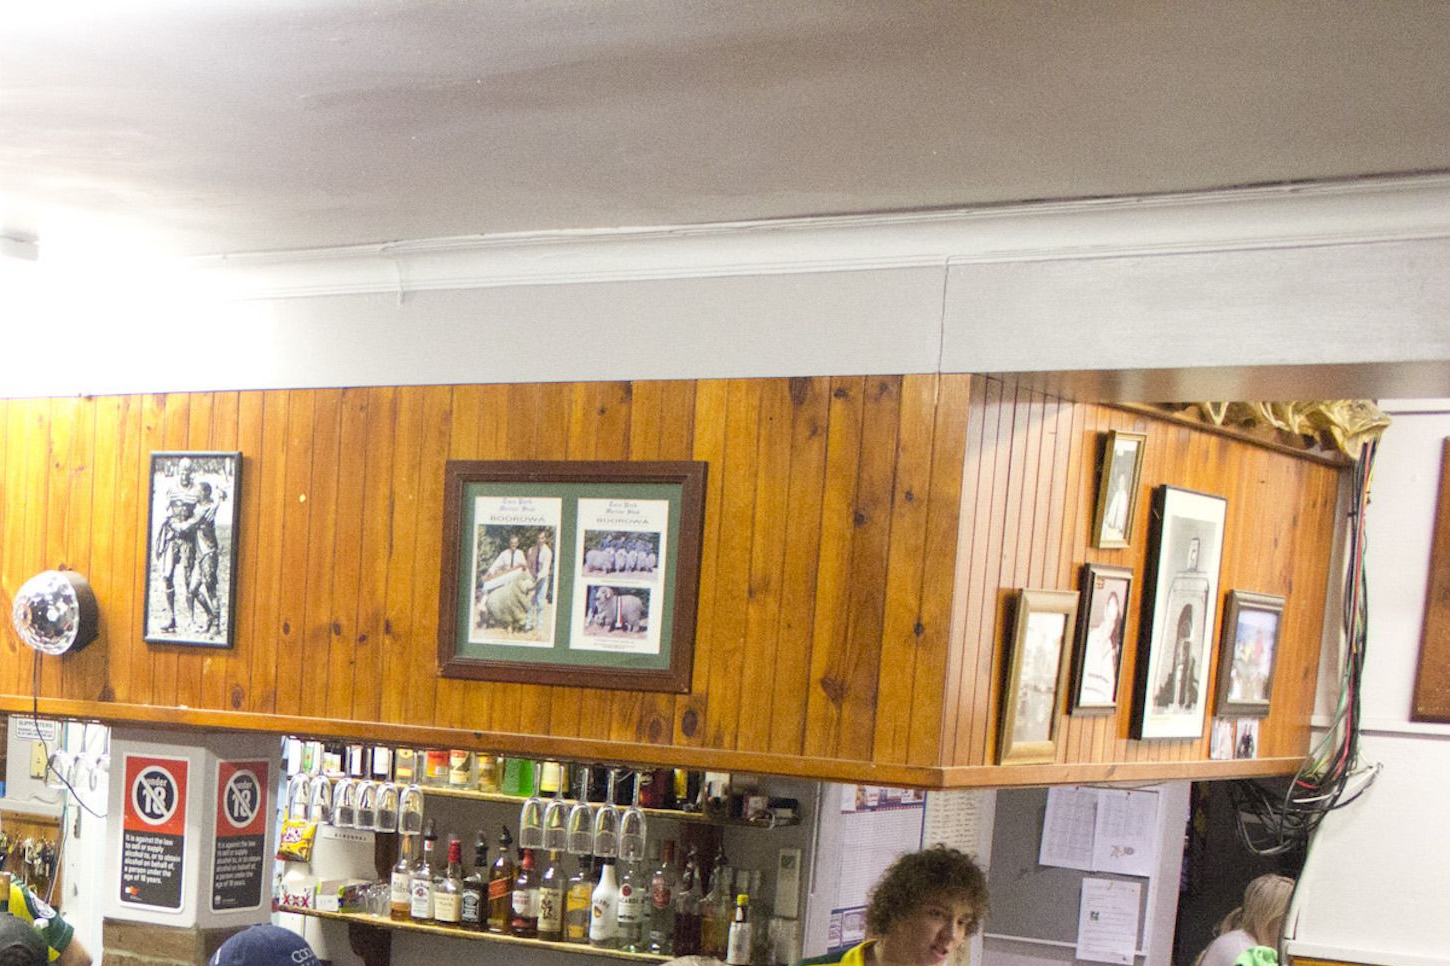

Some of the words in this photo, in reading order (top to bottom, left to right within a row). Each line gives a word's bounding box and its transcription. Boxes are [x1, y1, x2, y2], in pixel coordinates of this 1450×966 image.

[490, 514, 545, 522] BOOROWA
[142, 786, 167, 814] 18
[232, 790, 251, 817] 18
